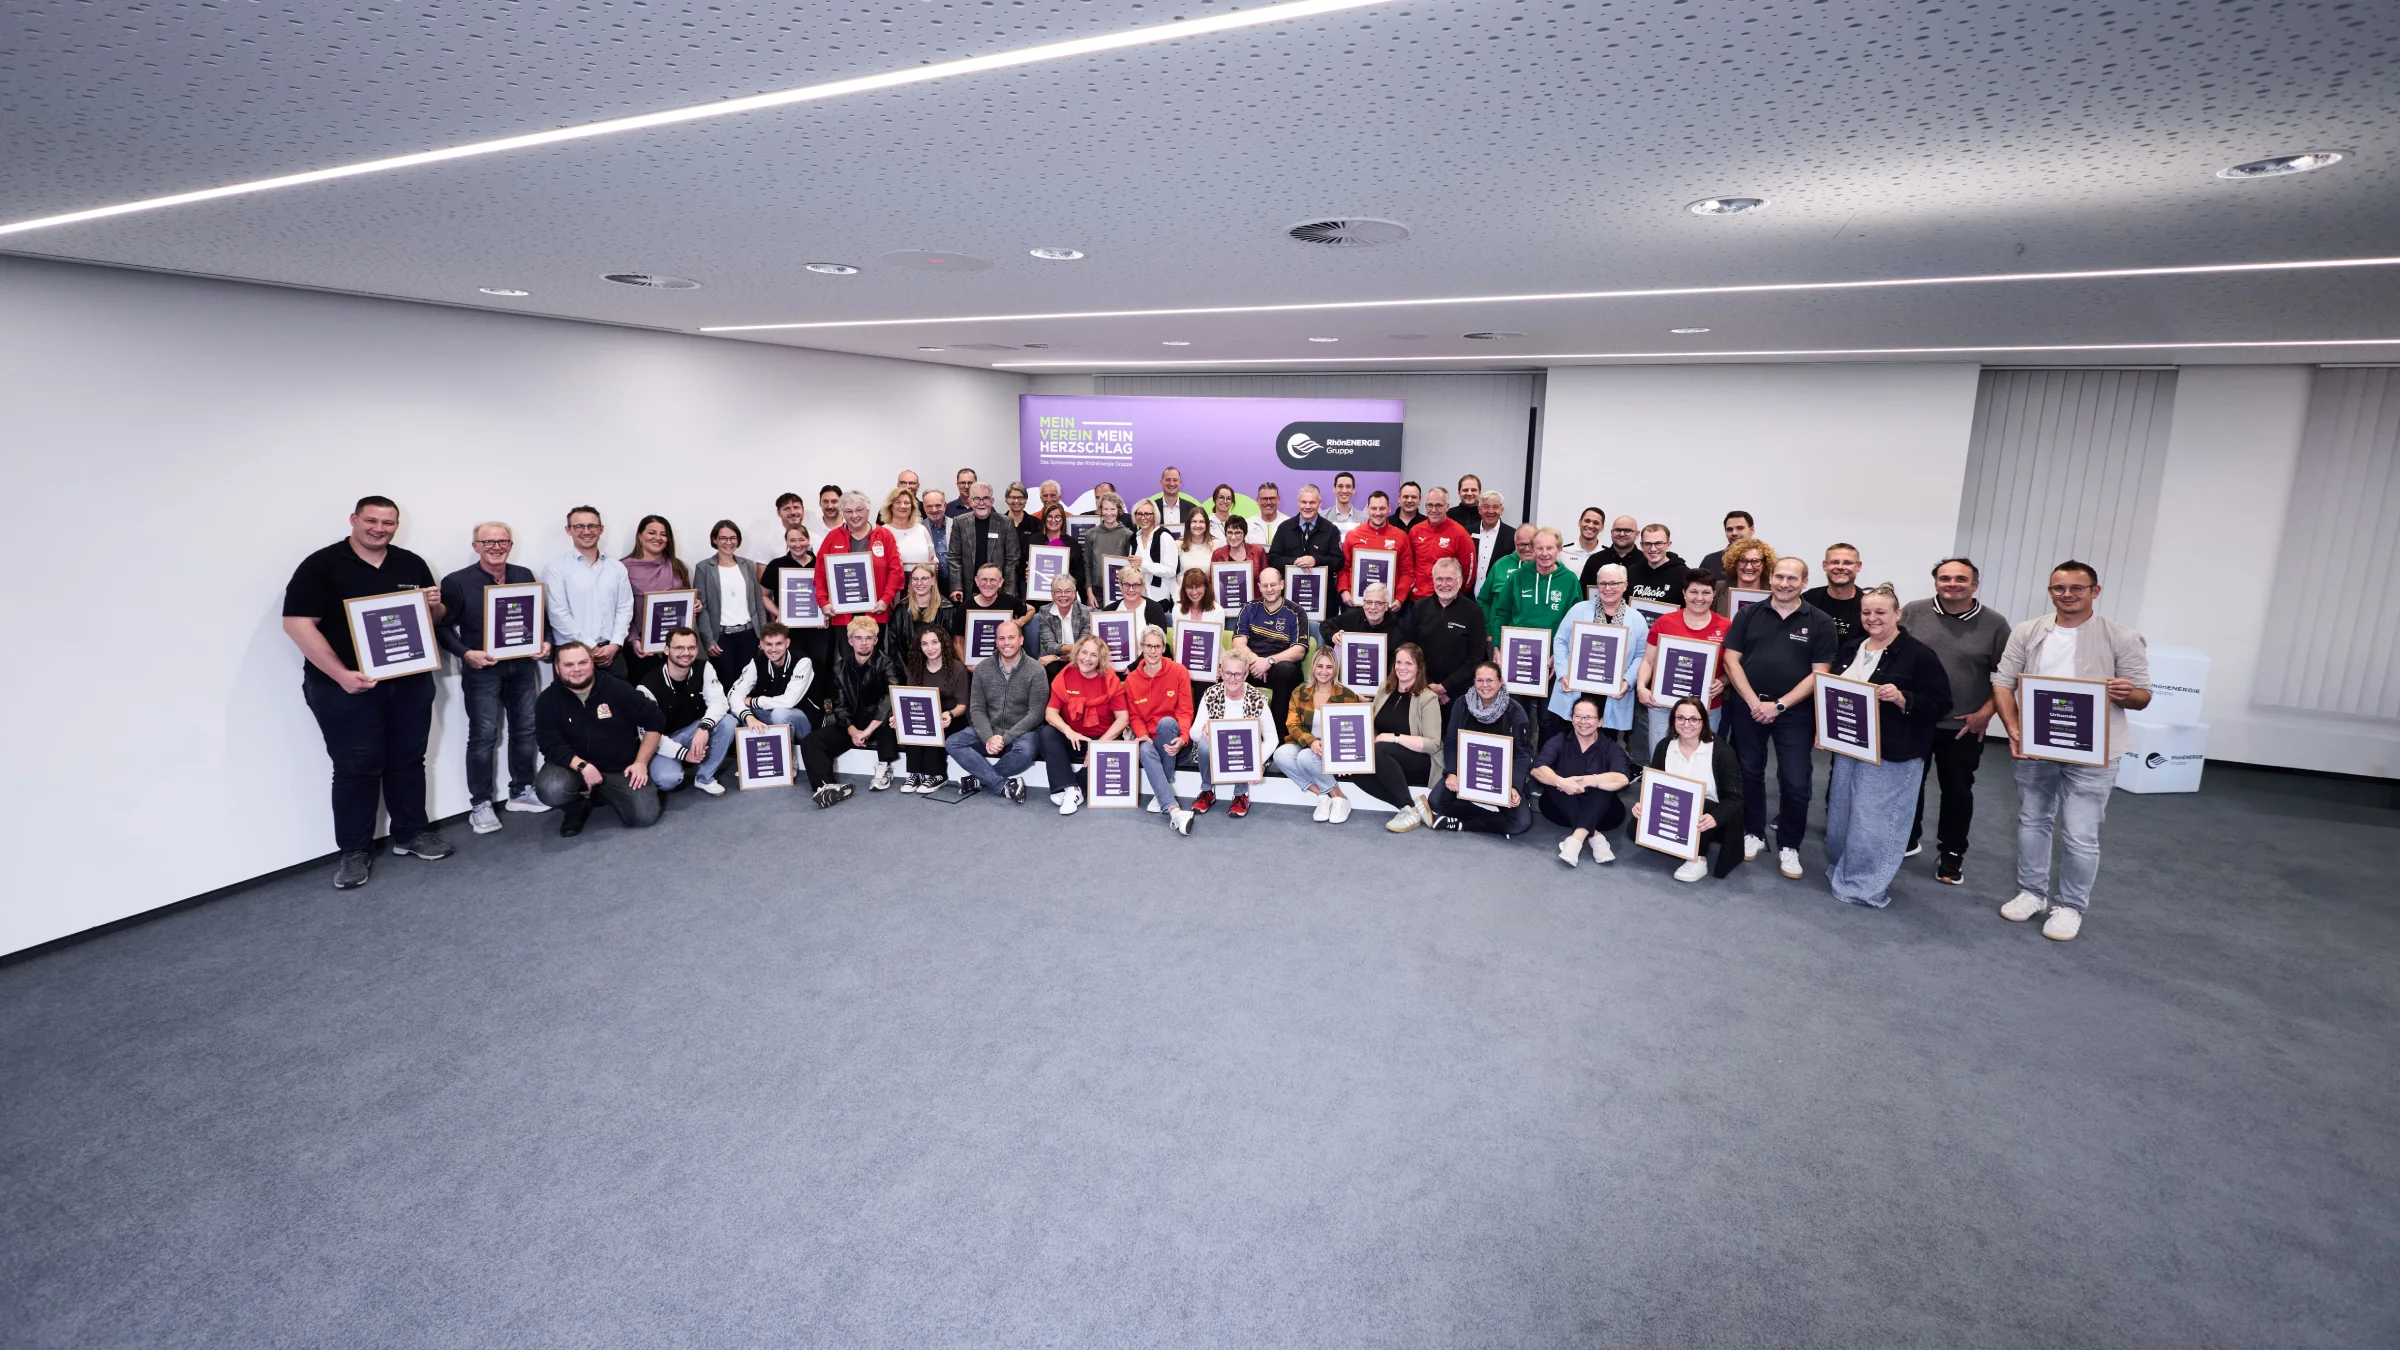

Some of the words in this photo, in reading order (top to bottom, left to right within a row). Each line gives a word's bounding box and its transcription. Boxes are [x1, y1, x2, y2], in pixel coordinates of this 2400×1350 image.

[1040, 416, 1075, 428] MEIN
[1040, 429, 1092, 441] VEREIN
[1097, 430, 1133, 442] MEIN
[1040, 441, 1133, 455] HERZSCHLAG
[1326, 439, 1381, 447] RhönENERGIE
[1326, 447, 1354, 455] Gruppe
[1836, 709, 1856, 717] Urkunde
